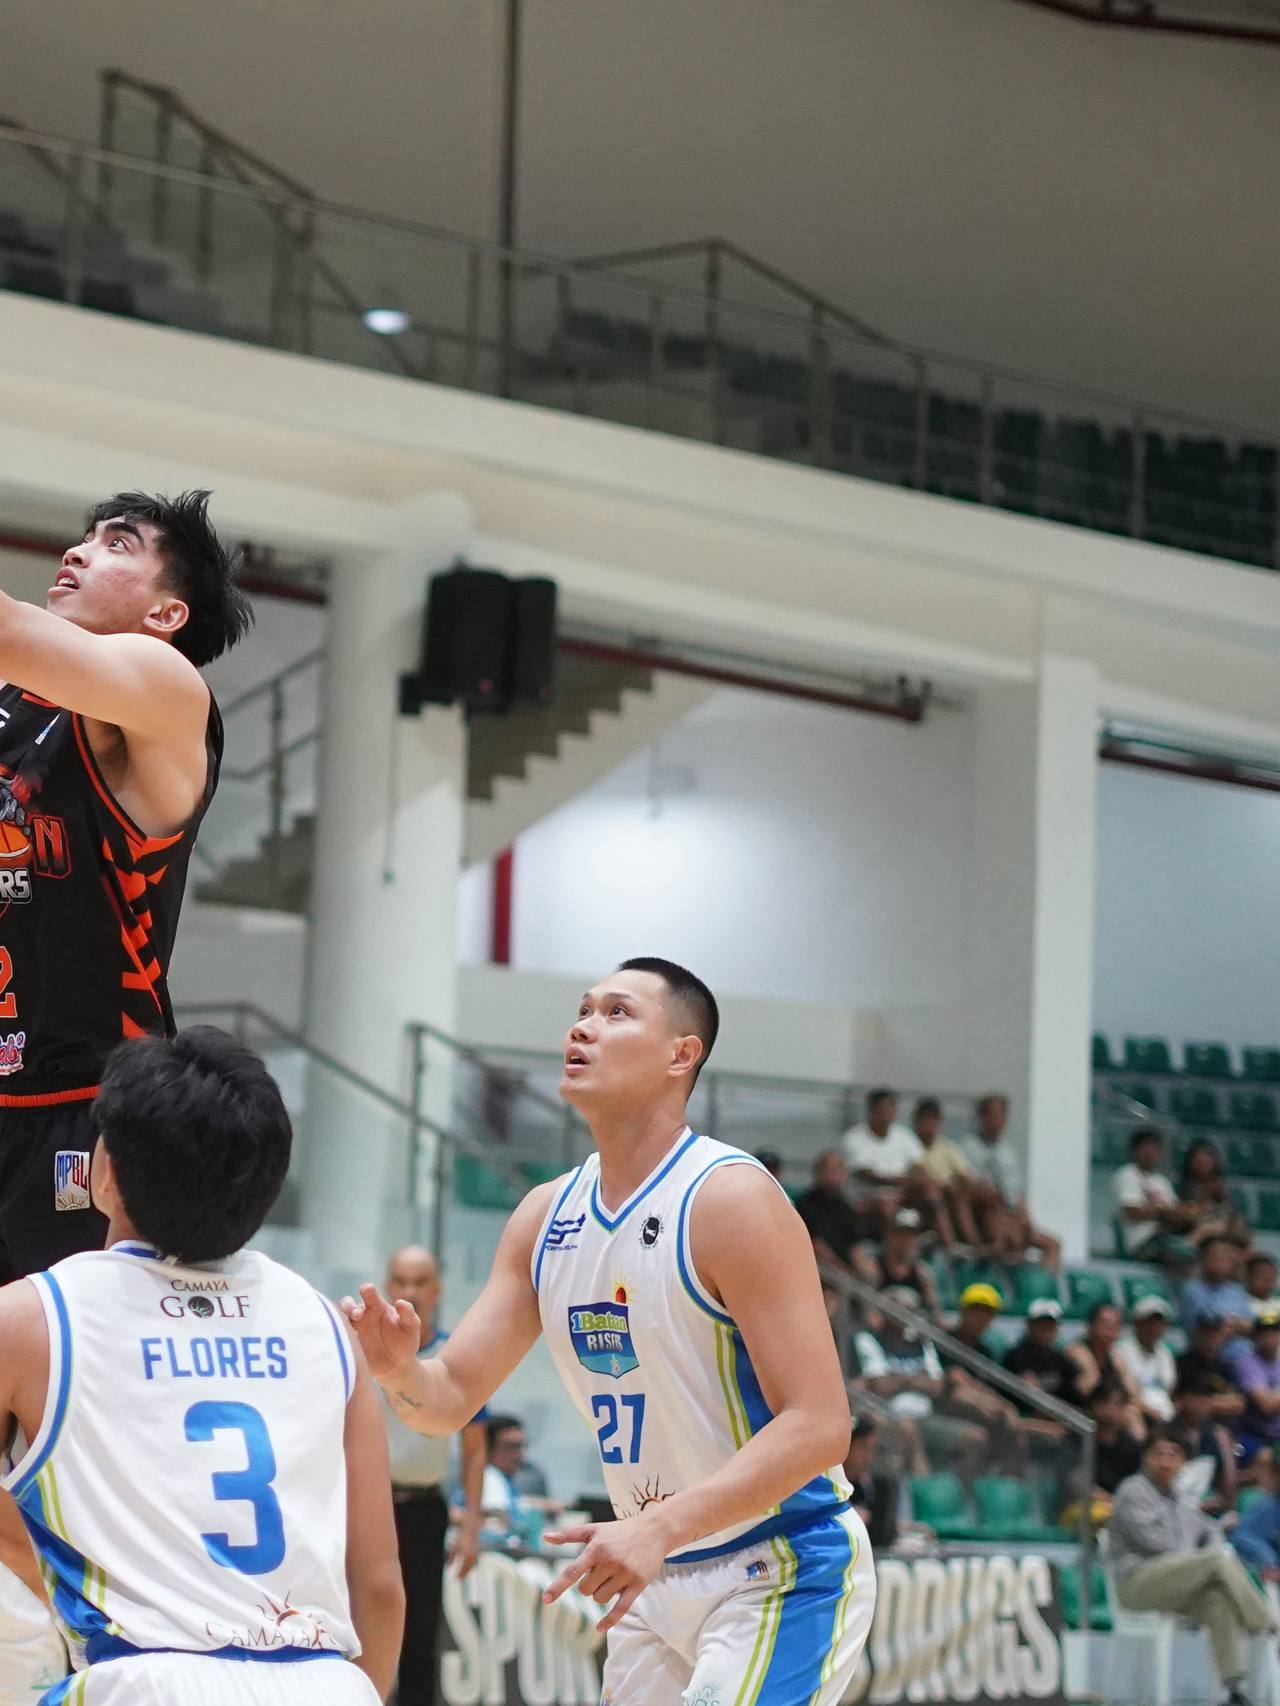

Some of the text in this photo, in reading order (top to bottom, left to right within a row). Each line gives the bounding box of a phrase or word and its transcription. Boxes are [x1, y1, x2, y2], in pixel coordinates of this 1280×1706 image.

[159, 1295, 250, 1319] GOLF
[171, 1279, 230, 1292] CAMAYA
[141, 1336, 288, 1380] FLORES
[591, 1393, 645, 1464] 27
[183, 1400, 286, 1575] 3
